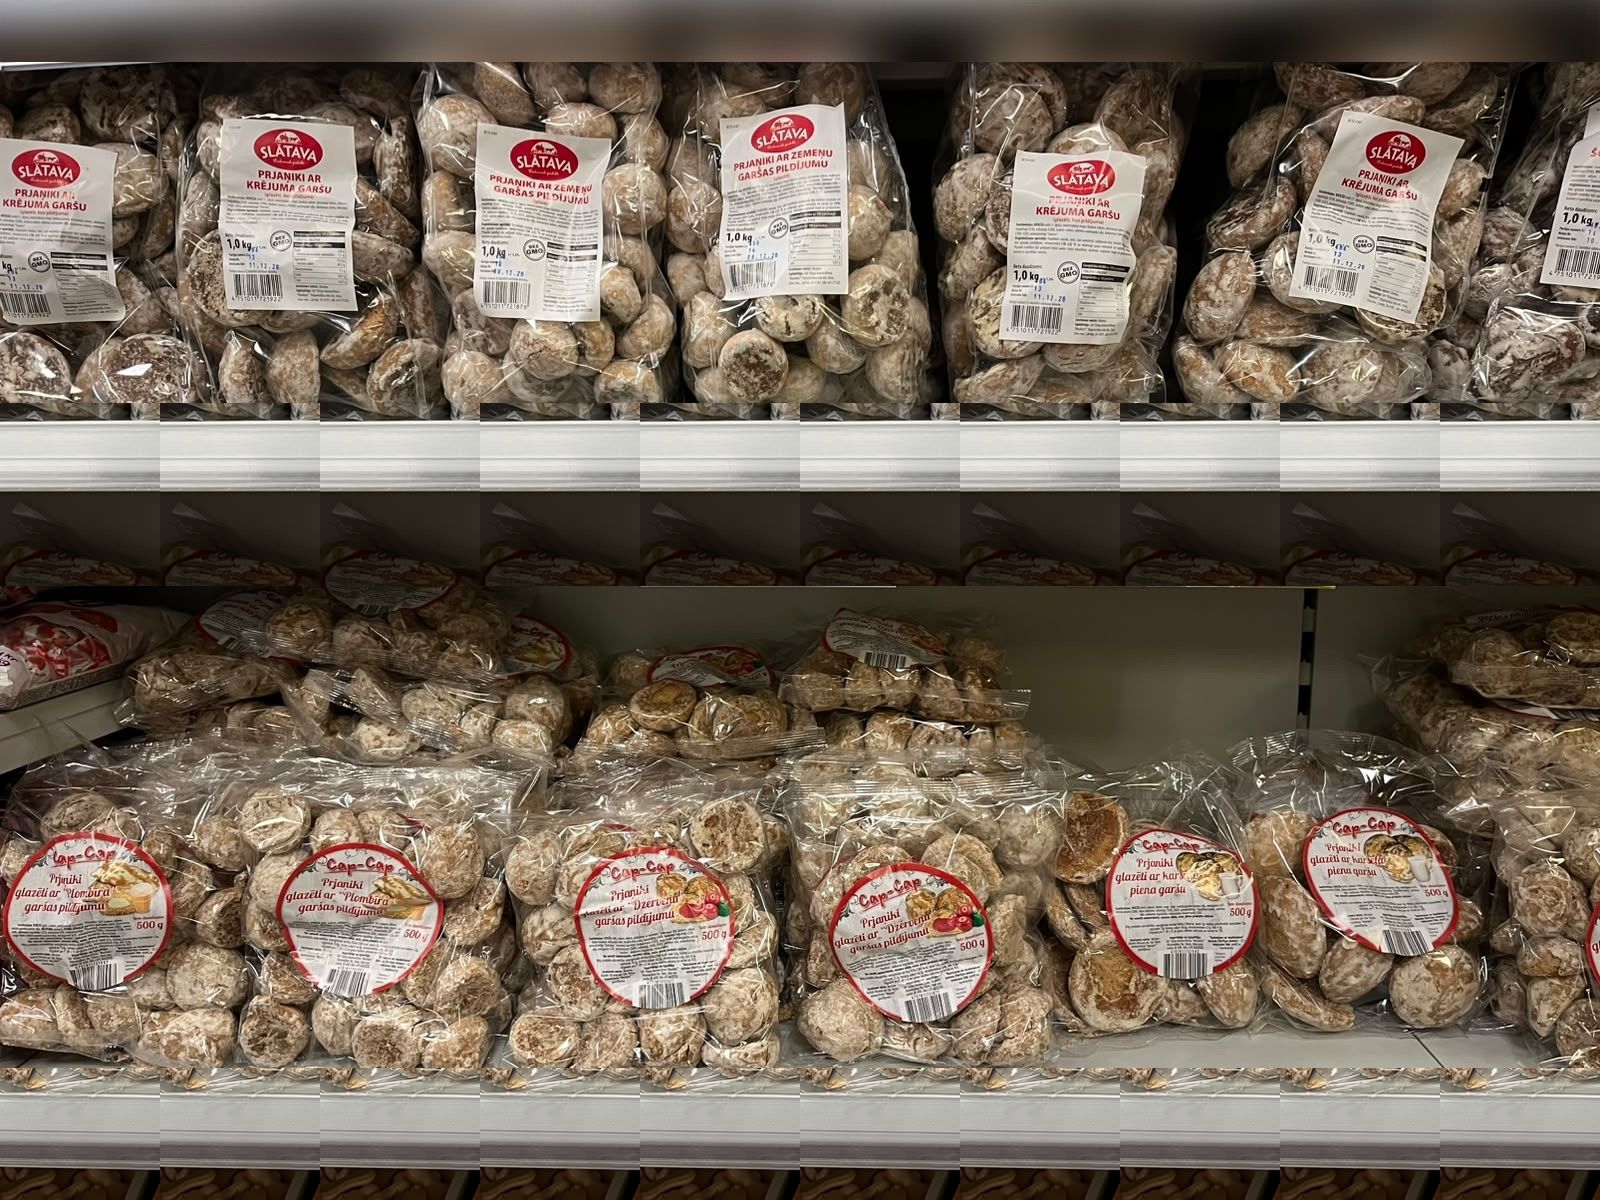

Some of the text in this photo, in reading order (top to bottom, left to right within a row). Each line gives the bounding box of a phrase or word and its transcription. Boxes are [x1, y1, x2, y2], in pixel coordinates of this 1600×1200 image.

[776, 153, 789, 162] AR
[308, 174, 321, 183] AR
[738, 167, 774, 181] GARŠAS
[538, 182, 552, 190] AR
[1341, 178, 1383, 196] KRĒJUMA
[1396, 179, 1409, 188] AR
[494, 185, 534, 197] GARŠAS
[52, 199, 87, 211] GARŠU
[1097, 198, 1110, 208] AR
[1087, 208, 1120, 220] GARŠU
[1563, 212, 1593, 227] 1,0 kg
[726, 232, 753, 246] 1,0 kg
[1308, 233, 1322, 244] 1,0
[227, 238, 252, 252] 1,0 kg
[482, 246, 506, 259] 1,0 kg
[1013, 270, 1027, 282] 1,0
[1029, 272, 1039, 283] kg
[1060, 270, 1078, 279] GMO
[1333, 816, 1397, 839] Cap-Cap
[1142, 838, 1200, 854] Cap-Cap
[1310, 854, 1340, 866] glazēti
[326, 856, 394, 877] Cap-Cap
[611, 860, 675, 881] Cap-Cap
[1327, 866, 1352, 878] piena
[1115, 871, 1148, 884] glazēti
[285, 889, 322, 903] glazēti
[859, 878, 922, 908] Cap-Cap
[1130, 884, 1186, 897] piena garšu
[1424, 889, 1449, 898] 500 g
[298, 901, 335, 915] garšas
[612, 905, 624, 913] ar
[1229, 908, 1252, 918] 500 g
[136, 921, 164, 930] 500 g
[403, 929, 421, 939] 500
[701, 930, 727, 941] 500 g
[834, 933, 866, 948] glazēti
[867, 930, 879, 939] ar
[960, 939, 985, 951] 500 g
